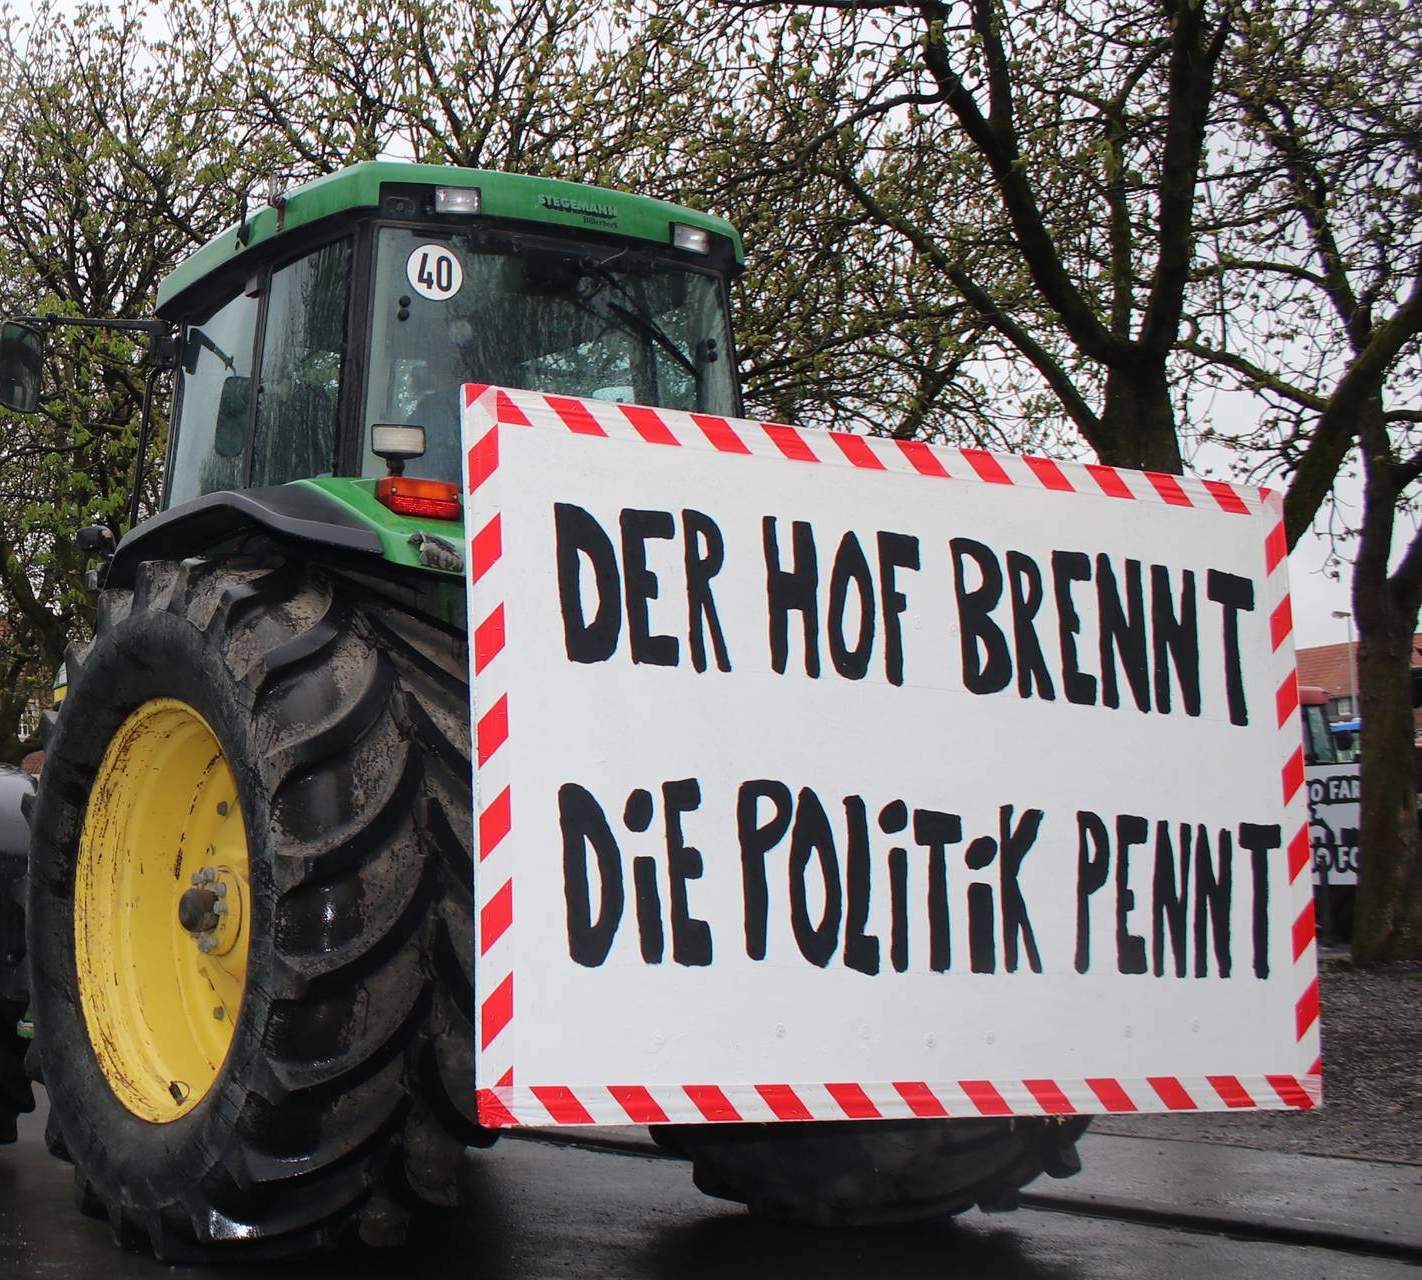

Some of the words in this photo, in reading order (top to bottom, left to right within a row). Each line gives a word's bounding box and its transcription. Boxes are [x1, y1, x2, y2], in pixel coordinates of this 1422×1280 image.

[538, 193, 618, 217] STEGEMANN
[418, 252, 453, 292] 40
[554, 503, 732, 673] DER
[763, 516, 921, 686] HOF
[950, 538, 1255, 726] BRENNT
[1075, 811, 1281, 979] PENNT
